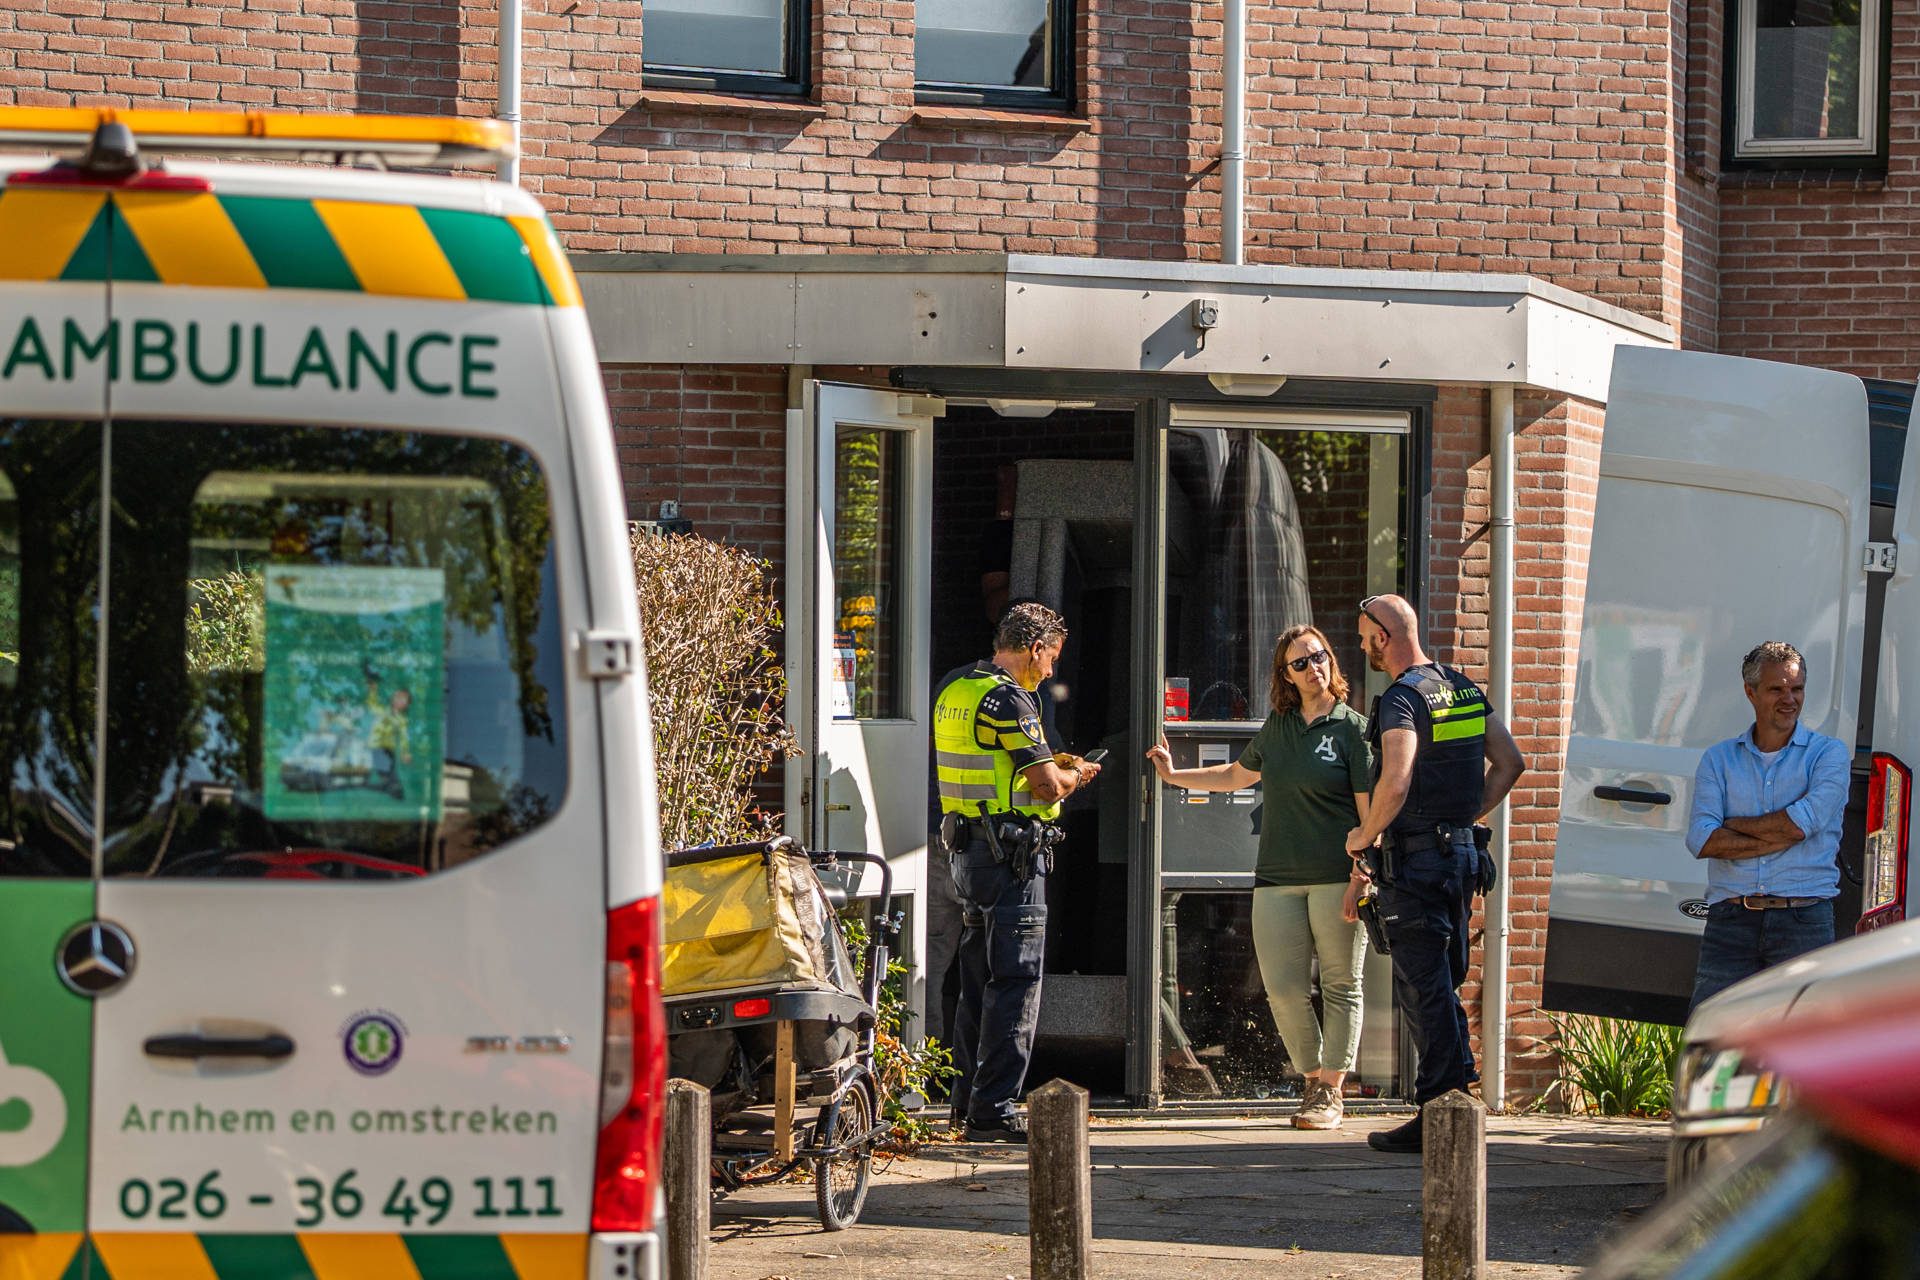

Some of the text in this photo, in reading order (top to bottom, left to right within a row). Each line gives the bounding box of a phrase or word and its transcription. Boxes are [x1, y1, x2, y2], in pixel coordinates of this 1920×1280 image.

[2, 316, 499, 398] AMBULANCE
[121, 1103, 557, 1134] Arnhem en omstreken
[119, 1169, 227, 1219] 026
[295, 1168, 364, 1227] 36
[381, 1176, 454, 1226] 49
[473, 1176, 563, 1217] 111
